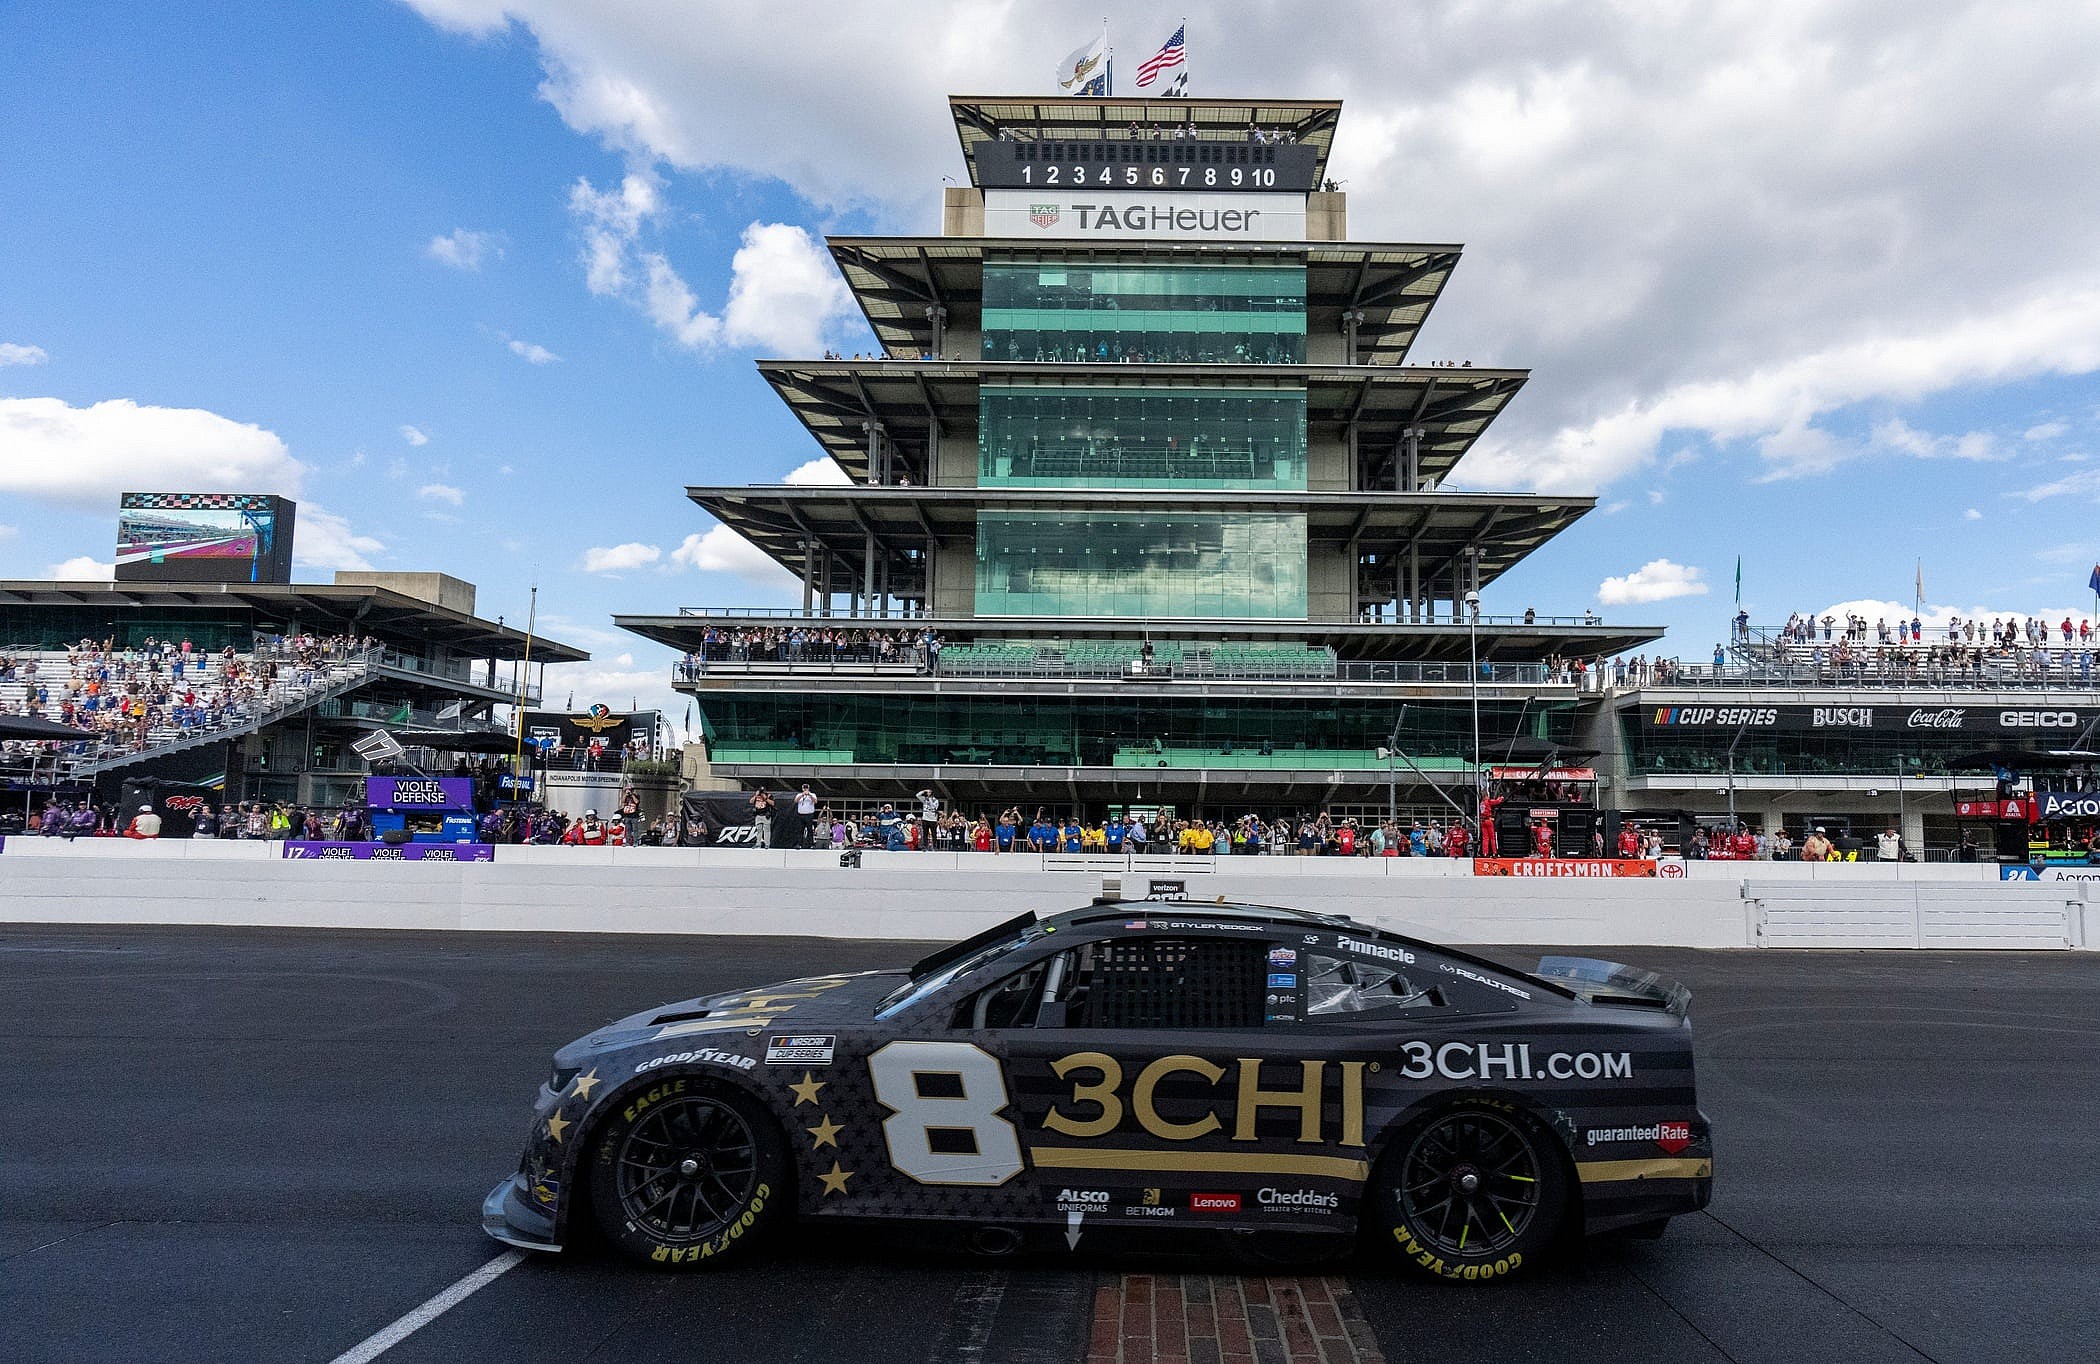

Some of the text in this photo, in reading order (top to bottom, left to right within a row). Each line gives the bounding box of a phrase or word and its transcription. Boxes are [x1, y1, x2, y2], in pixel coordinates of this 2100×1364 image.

[1022, 166, 1276, 187] 1 2 3 4 5 6 7 8 9 10
[1033, 206, 1057, 215] TAG
[1678, 707, 1778, 726] CUP SERIES
[1812, 707, 1874, 728] BUSCH
[1906, 708, 1967, 729] Coca-Cola
[1999, 711, 2078, 728] GEICO
[396, 780, 440, 792] VIOLET
[393, 792, 445, 803] DEFENSE
[2045, 795, 2100, 815] Acro
[287, 847, 305, 859] 17
[321, 847, 352, 856] VIOLET
[373, 848, 402, 857] VIOLET
[424, 850, 454, 858] VIOLET
[1513, 862, 1613, 877] CRAFTSMAN
[2008, 870, 2028, 881] 24
[1152, 884, 1179, 892] verizon
[1336, 935, 1416, 965] Pinnacle
[1454, 967, 1532, 1000] REALTREE
[1279, 994, 1296, 1005] ptc
[791, 1037, 827, 1046] NASCAR
[634, 1046, 757, 1074] GOODYEAR
[775, 1049, 825, 1058] CUP SERIES
[1399, 1040, 1634, 1081] 3CHI.COM
[623, 1078, 687, 1123] EAGLE
[866, 1040, 1026, 1187] 8
[1055, 1188, 1111, 1203] ALSCO
[1256, 1187, 1339, 1208] Cheddar's
[1056, 1203, 1109, 1213] UNIFORMS
[1193, 1197, 1237, 1209] Lenovo
[1125, 1206, 1175, 1217] BETMGM
